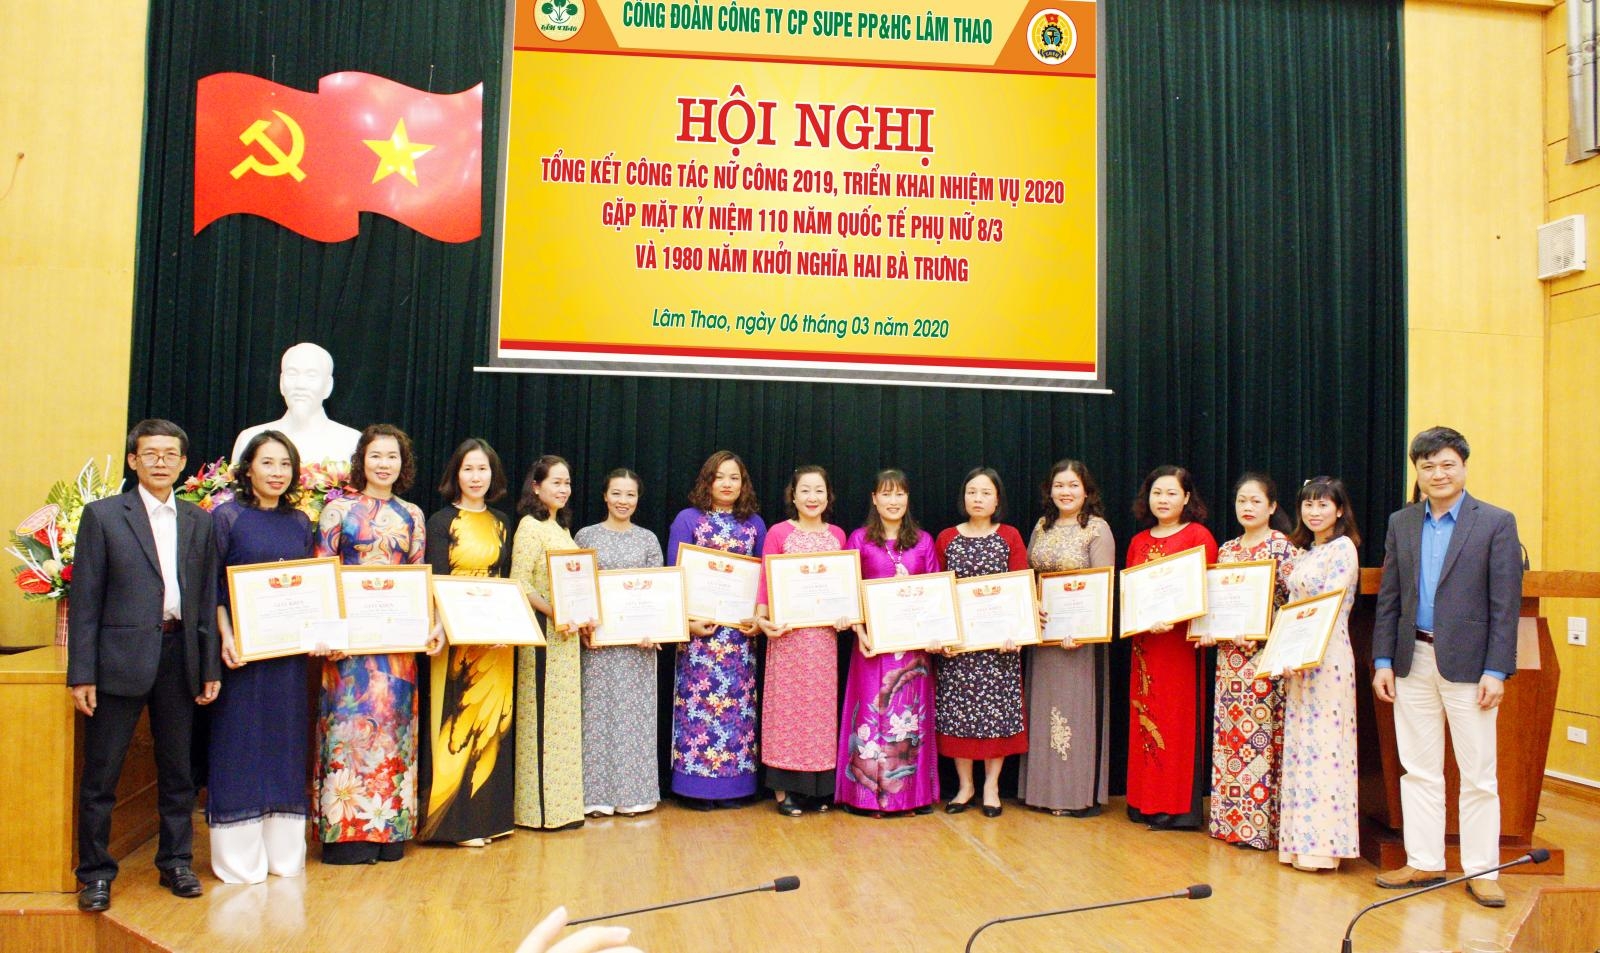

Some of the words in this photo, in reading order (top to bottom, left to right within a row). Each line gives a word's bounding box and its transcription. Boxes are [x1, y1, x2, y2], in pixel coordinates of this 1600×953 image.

[669, 0, 715, 32] ĐOÀN
[716, 2, 762, 34] CÔNG
[764, 7, 784, 34] TY
[786, 8, 809, 36] CP
[811, 9, 854, 39] SUPE
[856, 11, 913, 42] PP&HC
[914, 11, 950, 43] LÂM
[952, 16, 994, 46] THAO
[676, 85, 777, 157] HỘI
[794, 103, 934, 167] NGHỊ
[541, 149, 585, 183] TỔNG
[590, 153, 621, 185] KẾT
[625, 157, 673, 187] CÔNG
[677, 160, 709, 189] TÁC
[713, 160, 741, 190] NỮ
[742, 163, 788, 192] CÔNG
[792, 169, 838, 196] 2019,
[843, 163, 891, 197] TRIỂN
[895, 173, 935, 198] KHAI
[939, 172, 994, 204] NHIỆM
[999, 179, 1020, 207] VỤ
[1025, 179, 1065, 205] 2020
[602, 198, 637, 231] GẶP
[641, 200, 678, 233] MẶT
[682, 196, 704, 229] KỶ
[709, 202, 753, 236] NIỆM
[759, 209, 789, 233] 110
[793, 205, 833, 235] NĂM
[837, 205, 881, 238] QUỐC
[887, 207, 907, 238] TẾ
[911, 214, 945, 245] PHỤ
[949, 211, 974, 242] NỮ
[977, 218, 1003, 242] 8/3
[635, 240, 657, 269] VÀ
[663, 246, 703, 271] 1980
[707, 243, 747, 273] NĂM
[752, 240, 791, 275] KHỞI
[797, 249, 849, 277] NGHĨA
[853, 254, 881, 278] HAI
[886, 251, 909, 279] BÀ
[913, 255, 969, 282] TRƯNG
[651, 308, 687, 328] Lâm
[689, 308, 731, 331] Thao,
[735, 309, 778, 336] ngày
[778, 312, 799, 333] 06
[801, 312, 849, 340] tháng
[850, 314, 871, 336] 03
[872, 315, 910, 337] năm
[911, 318, 950, 339] 2020
